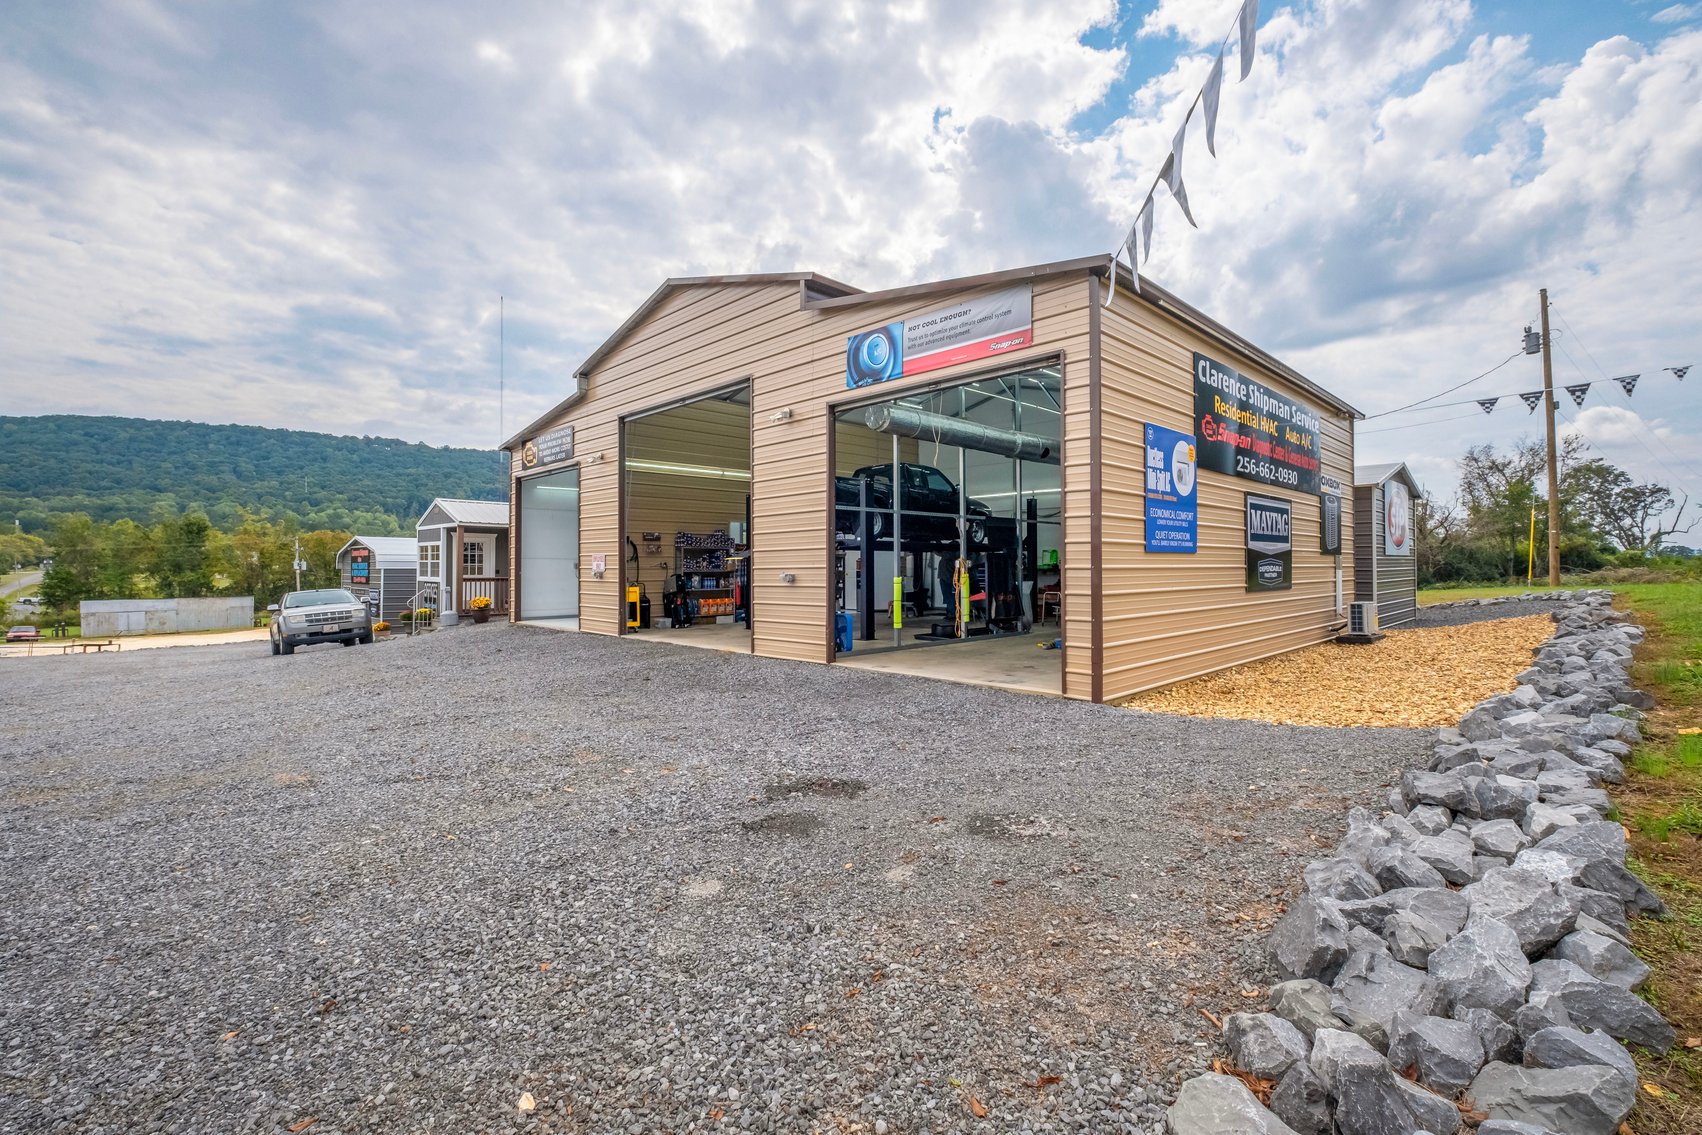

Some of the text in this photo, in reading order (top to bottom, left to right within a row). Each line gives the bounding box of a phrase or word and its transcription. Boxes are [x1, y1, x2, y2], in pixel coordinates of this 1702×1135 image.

[908, 309, 971, 332] NOT COOL ENOUGH?
[930, 328, 948, 337] optimize
[959, 320, 976, 328] climate
[977, 314, 993, 323] control
[994, 309, 1012, 319] system
[925, 336, 945, 345] advanced
[989, 338, 1024, 350] Snap-on
[1198, 359, 1319, 433] Clarence Shipman Service
[1214, 394, 1278, 436] Residential HVAC
[1217, 422, 1251, 449] Snap-on
[1285, 426, 1312, 450] Auto A/C
[1236, 455, 1298, 484] 256-662-0930
[1150, 507, 1194, 520] ECONOMICAL COMFORT
[1250, 509, 1288, 536] MAYTAG
[1390, 499, 1406, 537] STP
[1155, 530, 1190, 540] QUIET OPERATION
